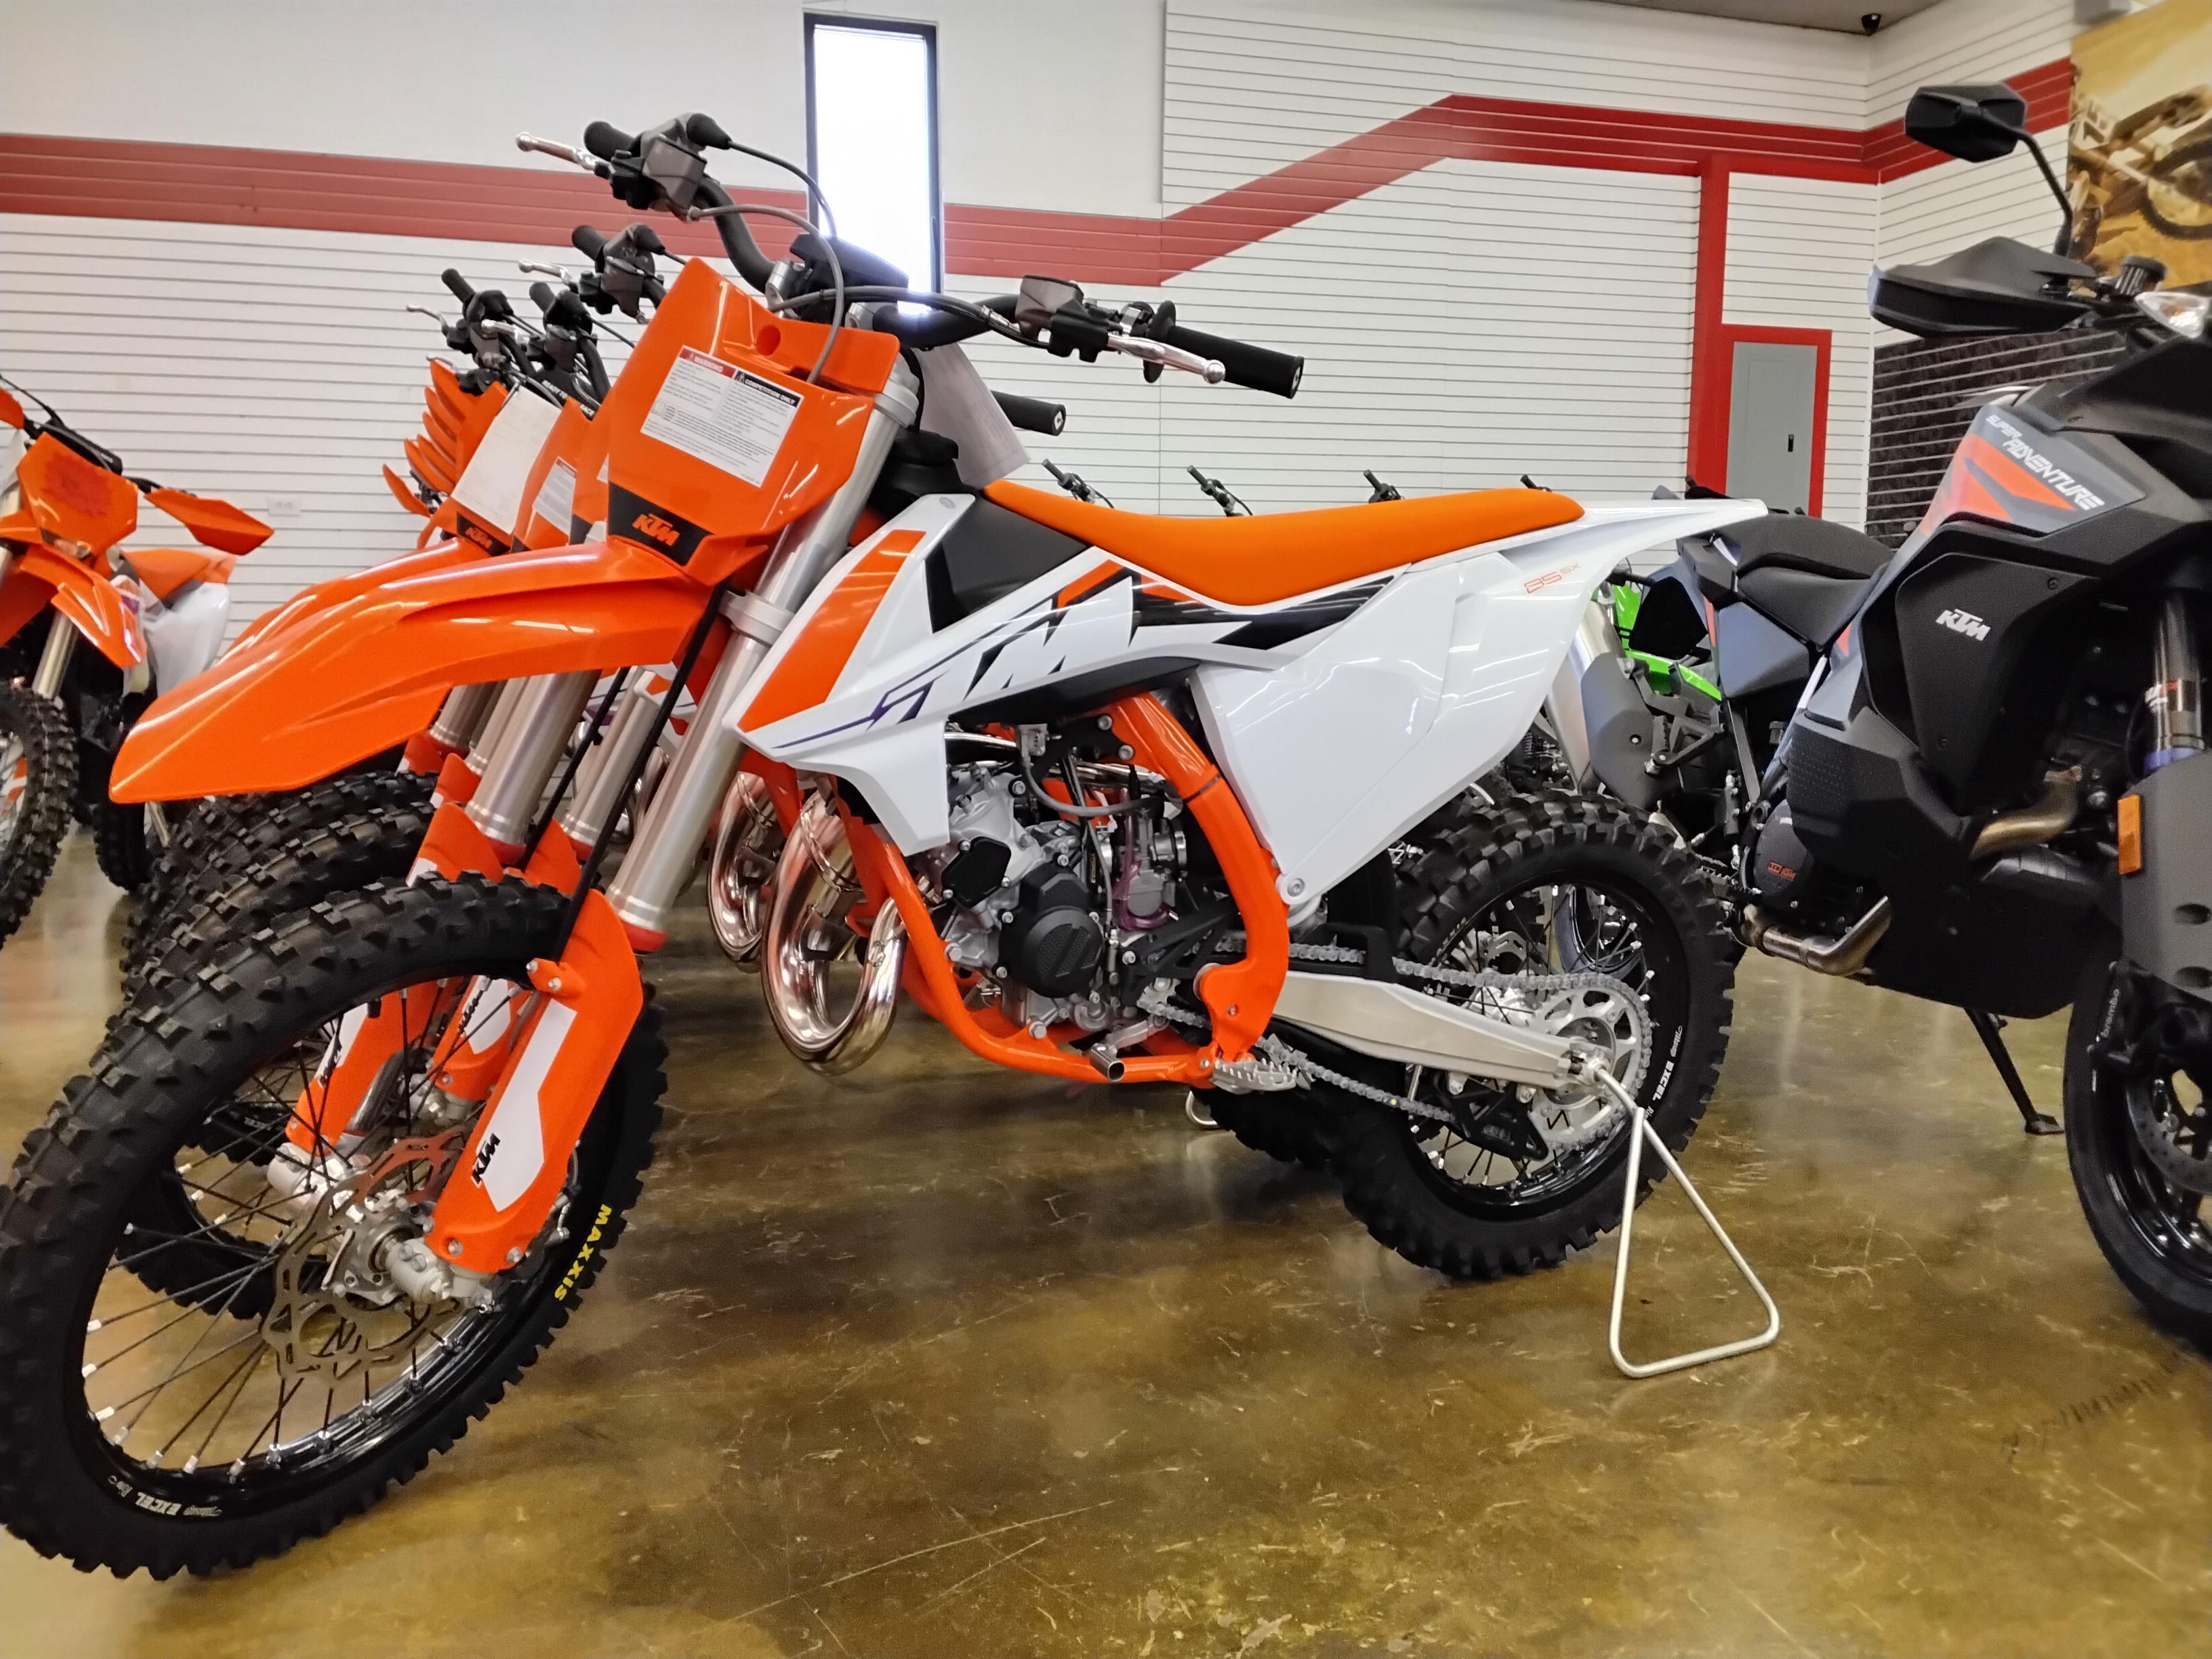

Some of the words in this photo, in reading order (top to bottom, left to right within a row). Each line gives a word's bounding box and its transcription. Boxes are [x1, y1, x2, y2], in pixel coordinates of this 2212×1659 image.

[745, 379, 779, 398] COMPETITION
[780, 394, 796, 405] ONLY
[1986, 414, 2022, 438] SUPER
[2003, 438, 2105, 510] ADVENTURE
[632, 514, 680, 546] KTM
[1525, 571, 1562, 594] 85
[1560, 563, 1581, 575] SX
[1936, 609, 1991, 640] KTM
[2100, 989, 2120, 1038] brembo
[1652, 1061, 1674, 1101] EXCEL
[472, 1132, 501, 1185] KTM
[554, 1204, 612, 1301] MAXXIS
[136, 1492, 182, 1516] EXCEL
